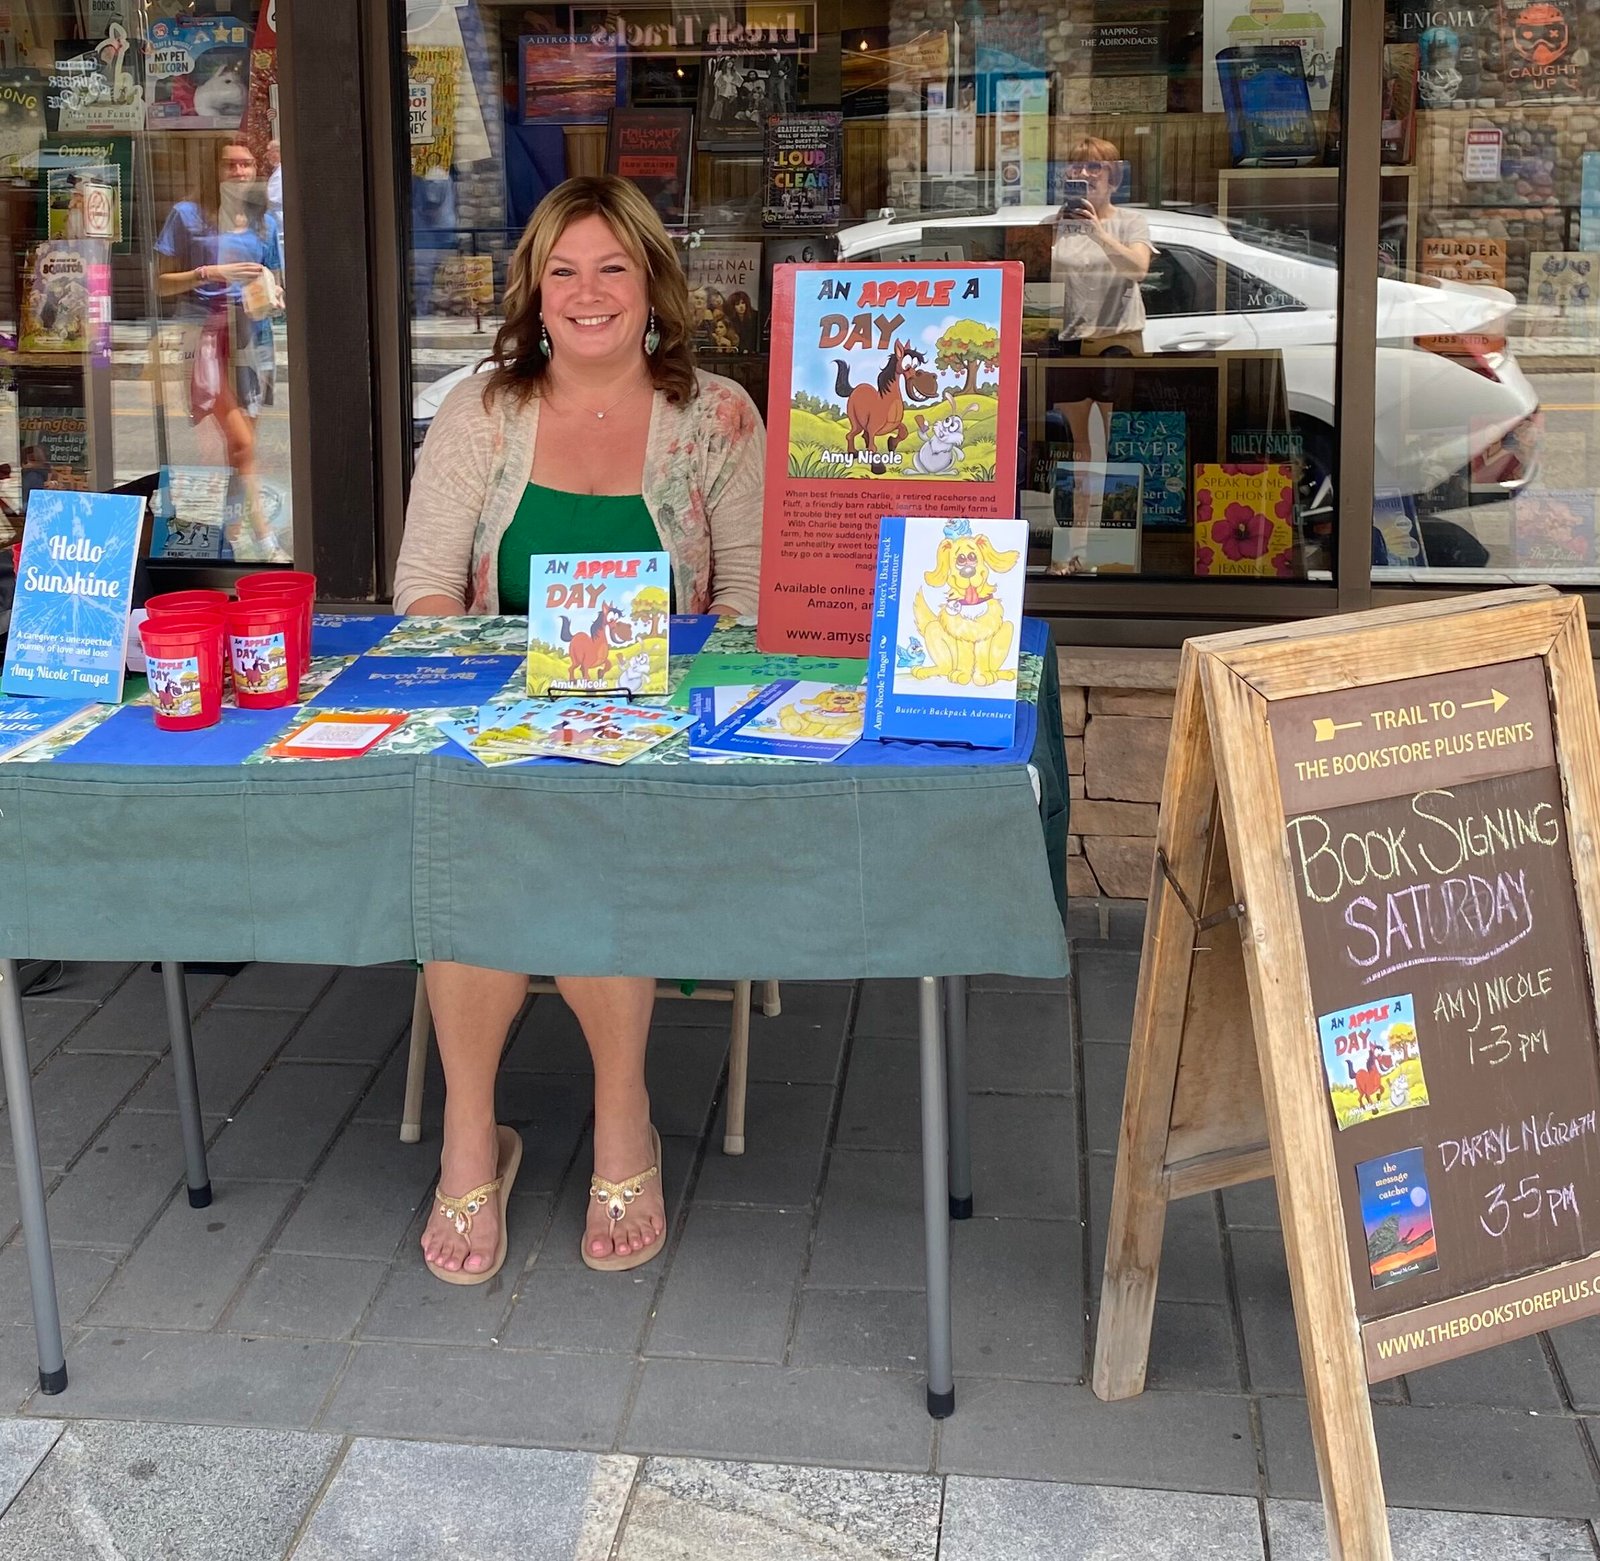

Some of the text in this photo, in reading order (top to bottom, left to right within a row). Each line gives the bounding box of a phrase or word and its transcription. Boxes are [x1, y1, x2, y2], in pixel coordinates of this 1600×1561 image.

[1403, 11, 1475, 30] ENIGMA
[1100, 28, 1139, 37] MAPPING
[1080, 36, 1159, 47] THE ADIRONDACKS
[1278, 39, 1308, 47] BOOKS
[154, 51, 186, 62] MY PET
[148, 62, 189, 74] UNICORN
[1509, 64, 1580, 78] CAUGHT
[1532, 78, 1557, 90] UP
[58, 143, 114, 158] Owney!
[779, 151, 826, 166] LOUD
[774, 172, 829, 188] CLEAR
[1426, 243, 1500, 258] MURDER
[692, 259, 755, 271] ETERNAL
[1467, 270, 1499, 281] NEST
[817, 278, 980, 308] AN APPLE A
[1247, 295, 1303, 306] MOTH
[818, 312, 905, 351] DAY
[1431, 335, 1457, 344] JESS
[1126, 420, 1168, 435] IS A
[50, 444, 82, 453] Special
[1115, 441, 1179, 456] RIVER
[1230, 435, 1263, 454] RILEY
[50, 453, 80, 463] Recipe
[820, 450, 903, 468] Amy Nicole
[1049, 450, 1082, 459] HOW TO
[1203, 477, 1283, 488] SPEAK TO ME
[785, 490, 809, 498] When
[829, 491, 858, 499] friends
[860, 491, 893, 501] Charlie,
[933, 493, 978, 502] racehorse
[1214, 490, 1275, 501] OF HOME
[811, 500, 843, 510] friendly
[845, 501, 865, 509] barn
[866, 501, 894, 511] rabbit,
[924, 503, 938, 511] the
[940, 503, 966, 513] family
[968, 504, 988, 512] farm
[990, 505, 998, 513] is
[790, 510, 822, 519] trouble
[822, 510, 841, 520] they
[48, 534, 106, 564] Hello
[544, 557, 658, 580] AN APPLE A
[1218, 563, 1267, 575] JEANINE
[23, 566, 121, 599] Sunshine
[876, 537, 892, 618] Buster's Backpack
[888, 553, 900, 601] Adventure
[545, 582, 608, 610] DAY
[774, 583, 868, 596] Available online
[807, 599, 858, 611] Amazon,
[16, 630, 113, 648] A caregiver's unexpected
[16, 642, 109, 658] journey of love and loss
[236, 648, 258, 659] DAY
[156, 661, 184, 670] APPLE
[763, 656, 799, 664] THE
[10, 663, 110, 688] Amy Nicole Tangel
[150, 669, 170, 681] DAY
[368, 672, 477, 680] BOOKSTORE
[576, 679, 608, 689] Nicole
[873, 648, 889, 730] Amy Nicole Tangel
[576, 700, 600, 708] AN
[599, 705, 668, 720] APPLE
[895, 705, 1013, 720] Buster's Backpack Adventure
[1370, 700, 1456, 731] TRAIL TO
[1294, 722, 1534, 781] THE BOOKSTORE PLUS EVENTS
[1286, 788, 1561, 904] BOOK SIGNING
[1344, 867, 1534, 967] SATURDAY
[1432, 967, 1553, 1033] AMY NICOLE
[1330, 1001, 1402, 1031] AN APPLE A
[1334, 1028, 1372, 1057] DAY
[1437, 1122, 1520, 1172] DARRYL
[1383, 1162, 1397, 1173] the
[1375, 1173, 1409, 1187] message
[1378, 1185, 1409, 1200] catcher
[1479, 1173, 1542, 1238] 3-5
